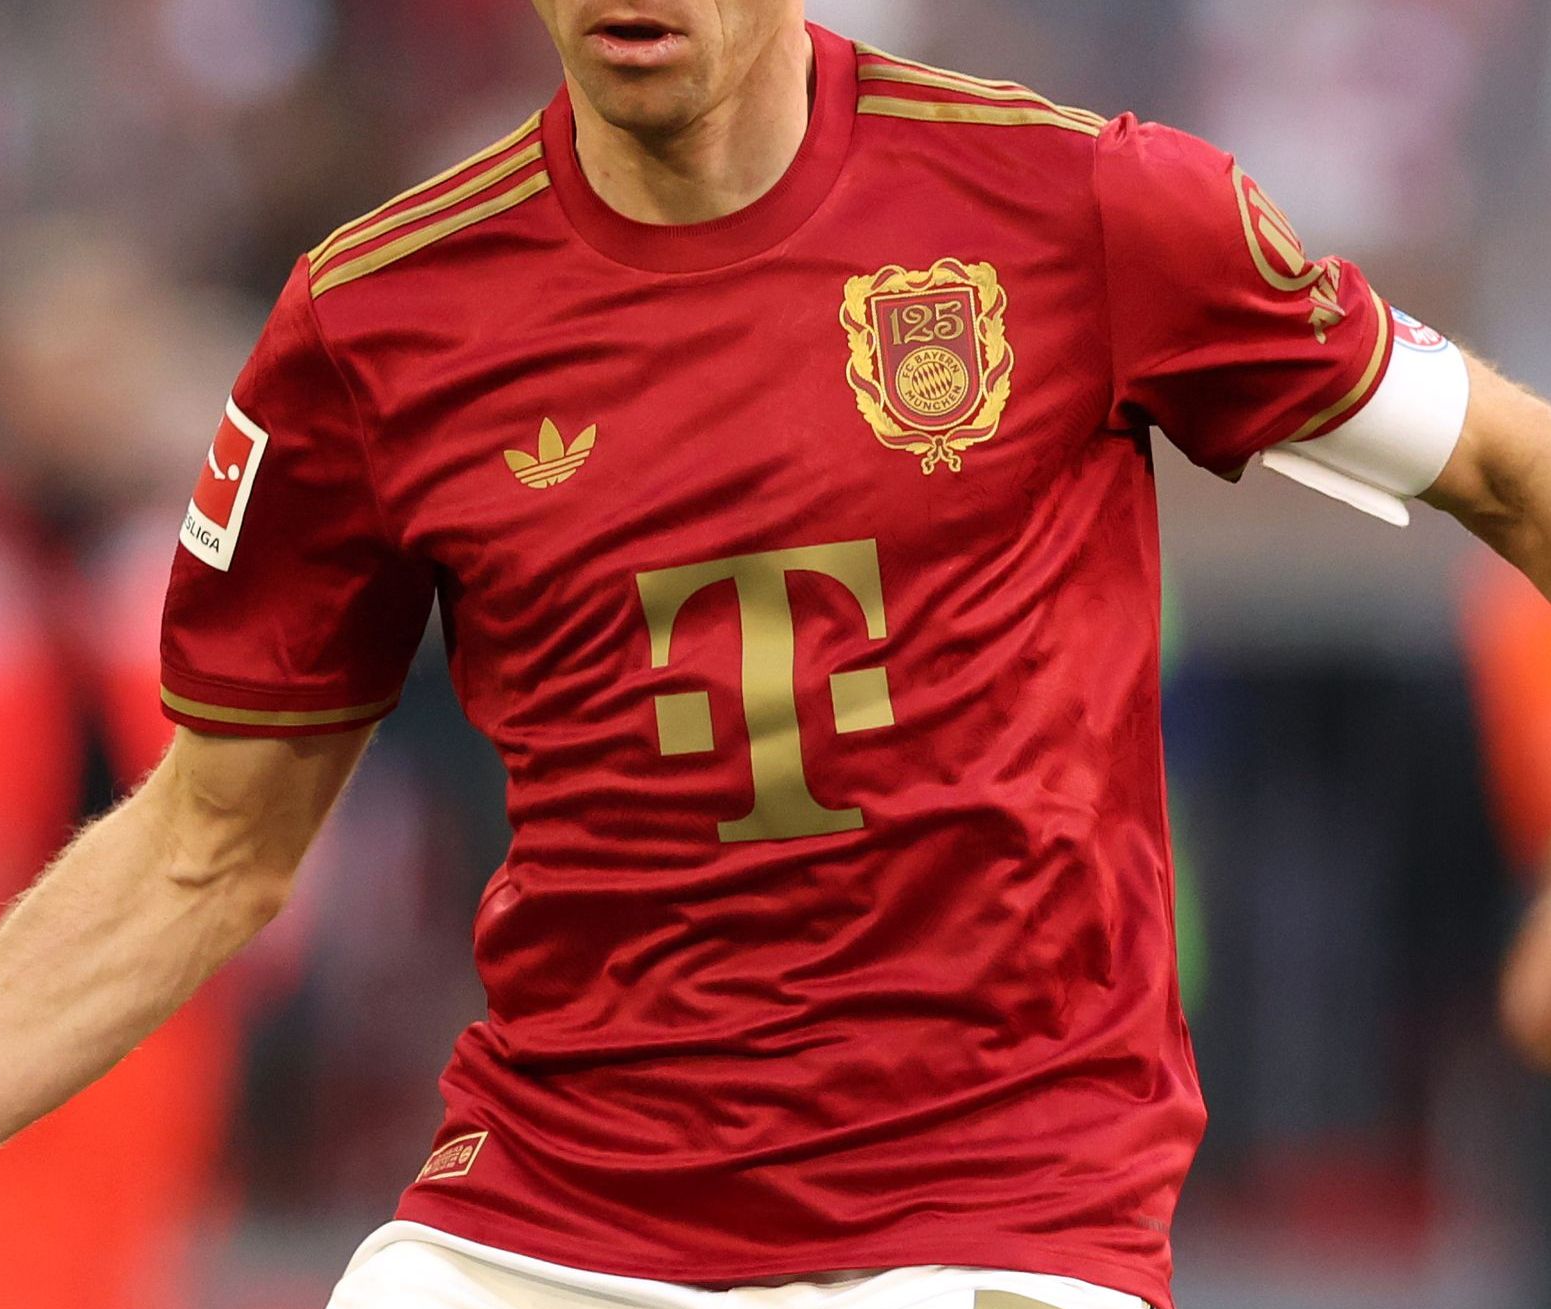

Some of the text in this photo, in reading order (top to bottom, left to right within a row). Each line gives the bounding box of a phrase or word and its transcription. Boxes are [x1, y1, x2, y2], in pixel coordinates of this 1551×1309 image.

[890, 301, 964, 345] 125
[903, 351, 960, 379] FC BAYERN
[185, 513, 220, 553] SLIGA
[636, 538, 895, 843] T
